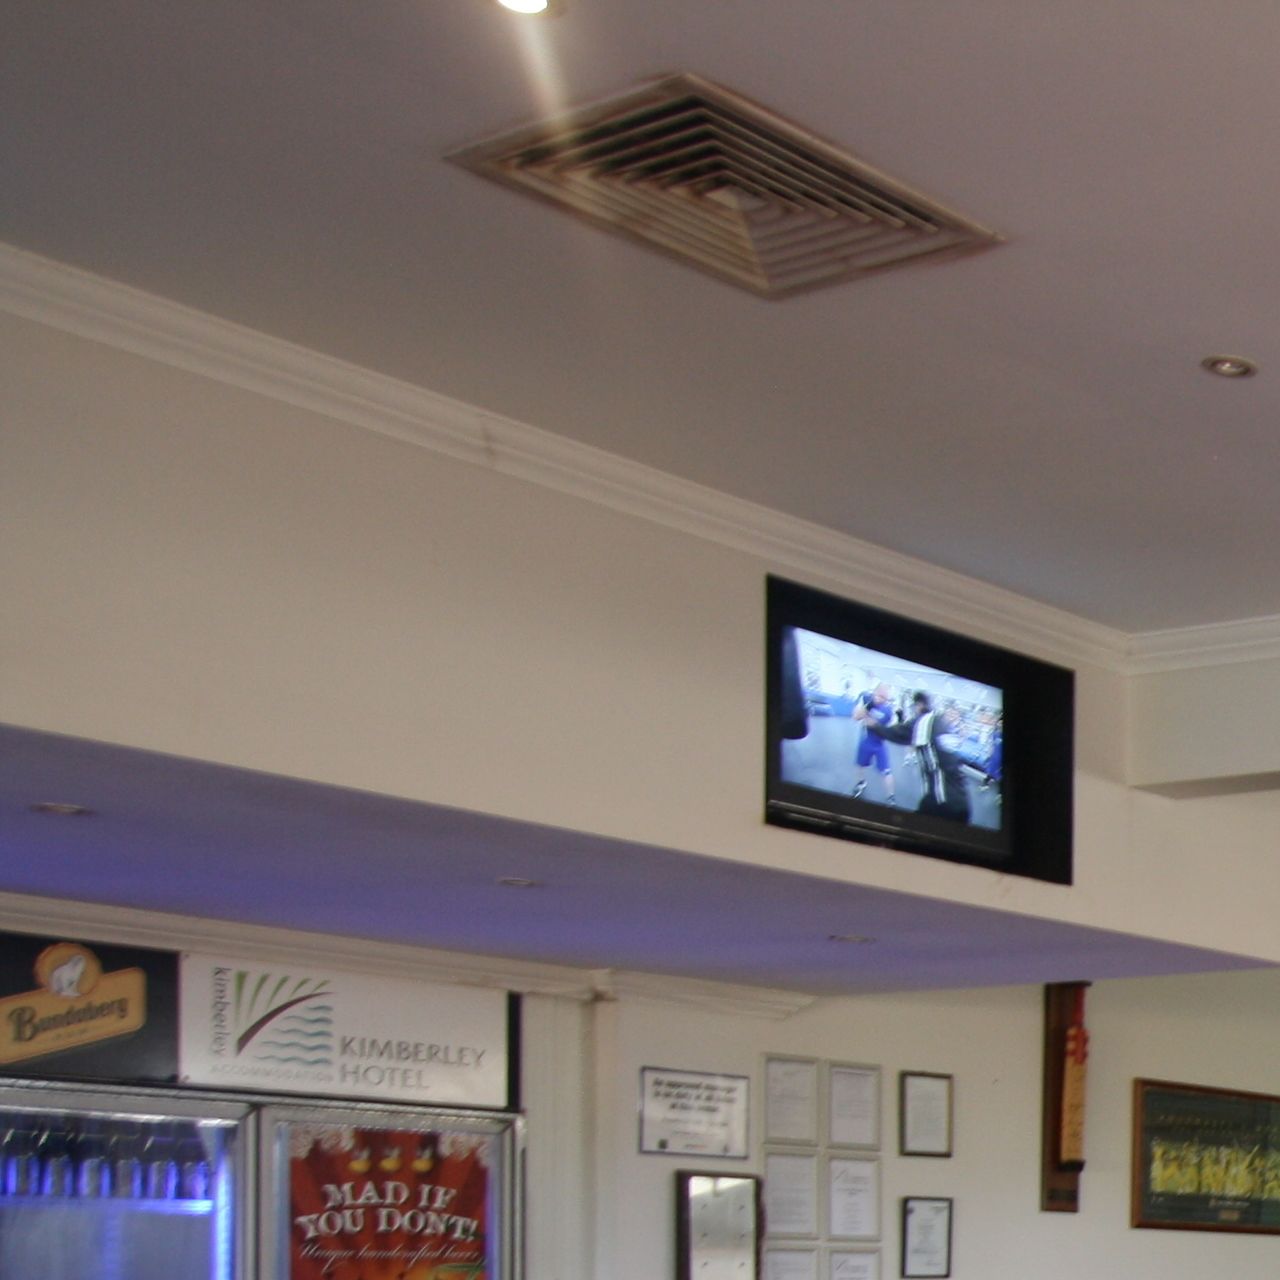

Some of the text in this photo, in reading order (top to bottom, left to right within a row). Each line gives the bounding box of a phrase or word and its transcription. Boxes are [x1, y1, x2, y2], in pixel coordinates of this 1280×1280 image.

[211, 966, 232, 1057] kimberley
[339, 1035, 487, 1067] KIMBERLEY
[339, 1064, 431, 1090] HOTEL
[322, 1181, 457, 1210] MAD IF
[295, 1208, 365, 1241] YOU
